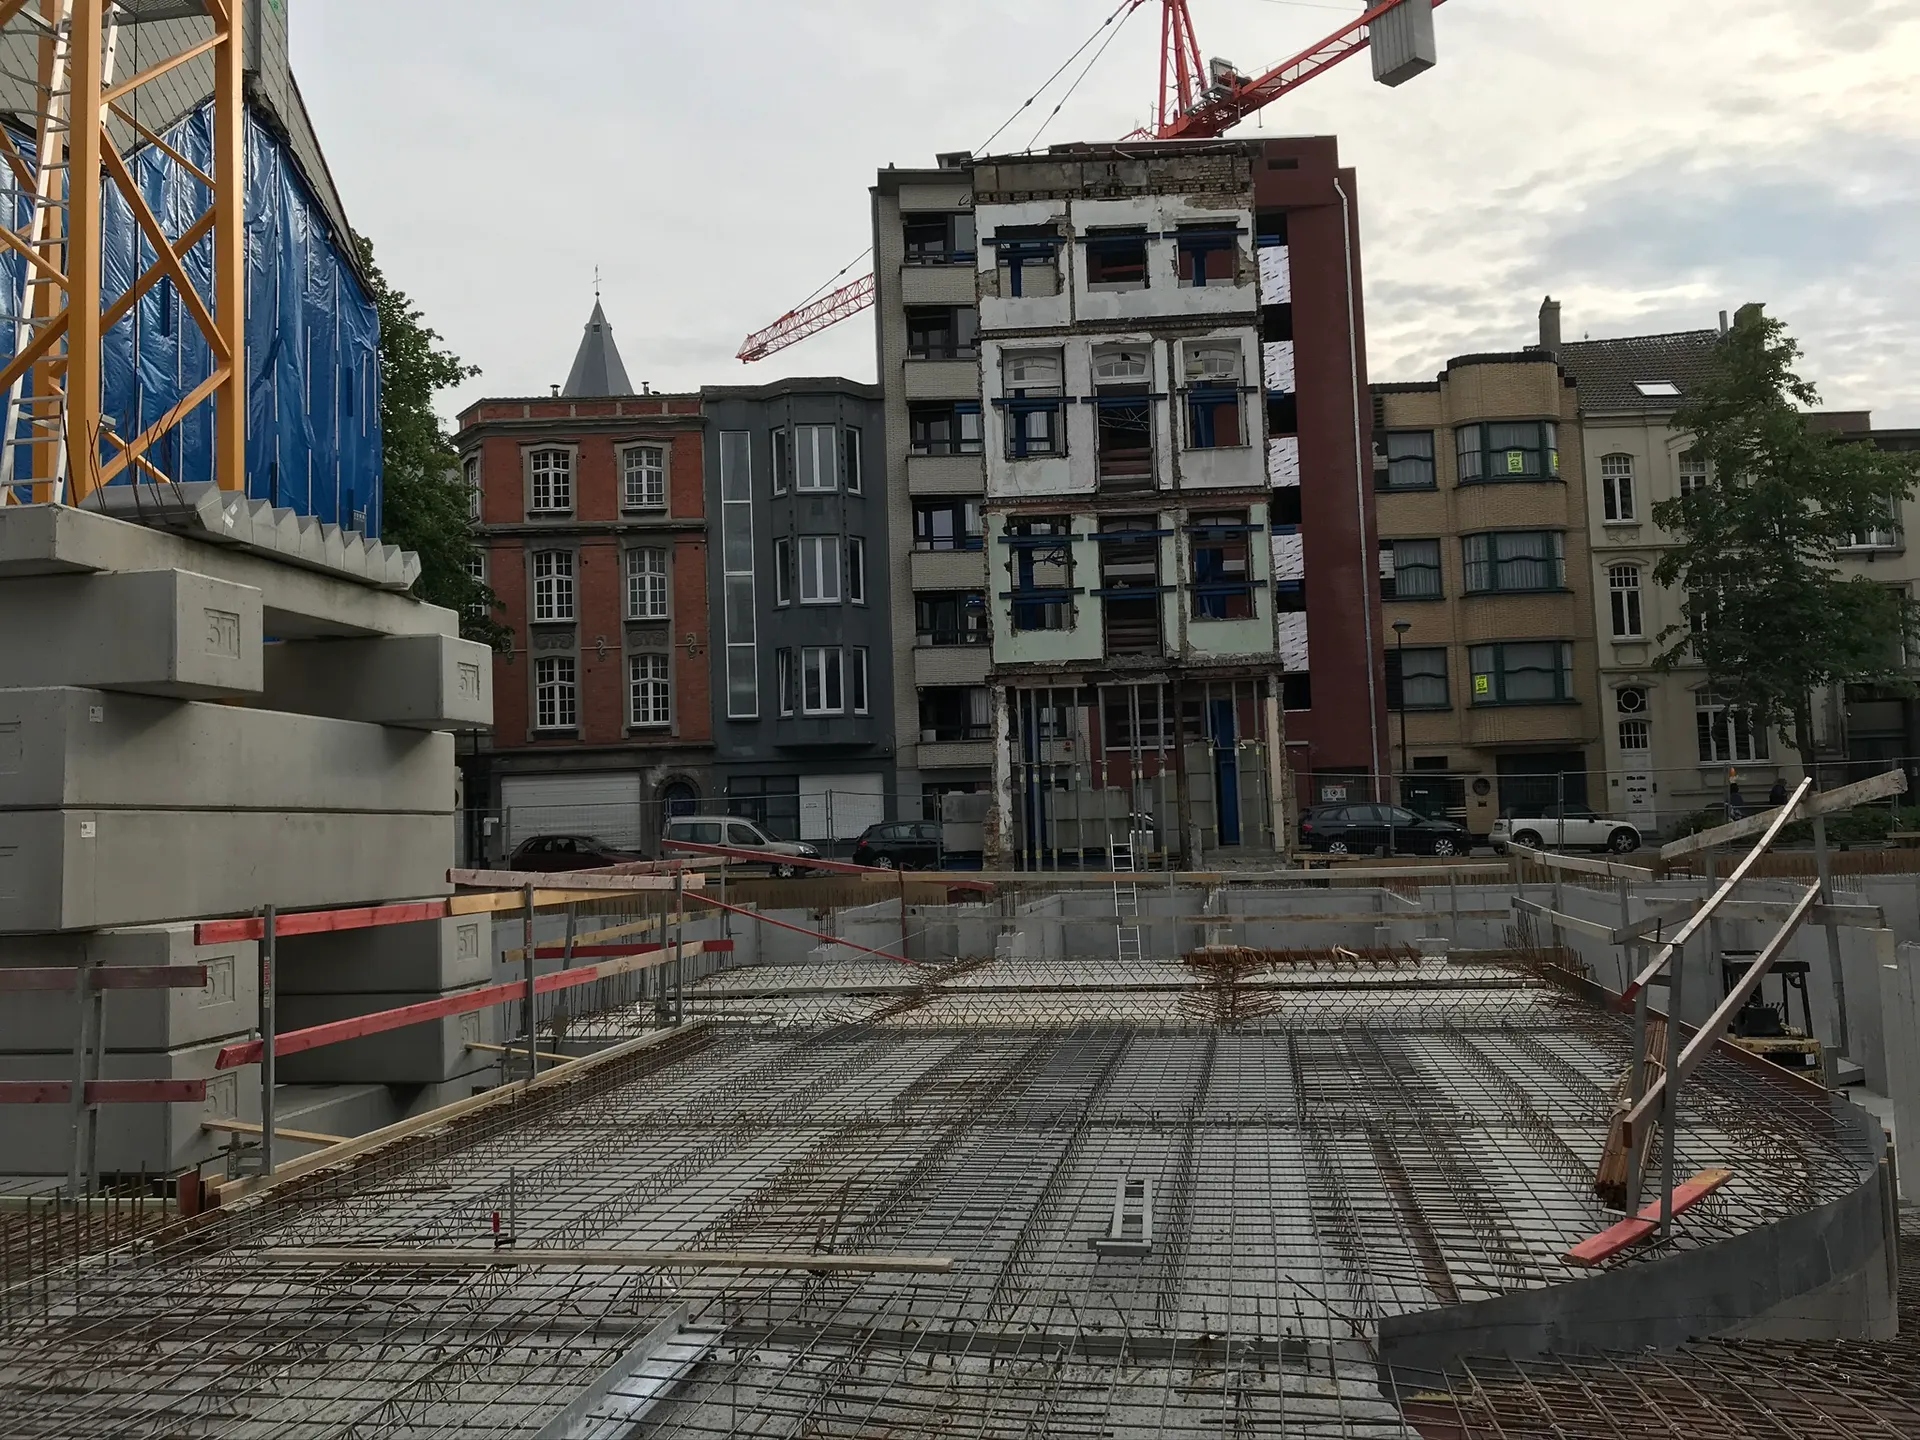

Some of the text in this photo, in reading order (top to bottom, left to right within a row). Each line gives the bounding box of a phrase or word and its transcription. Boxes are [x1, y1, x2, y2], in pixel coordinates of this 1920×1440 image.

[206, 615, 236, 652] 5T
[459, 668, 476, 697] 5T
[459, 928, 476, 956] 5T
